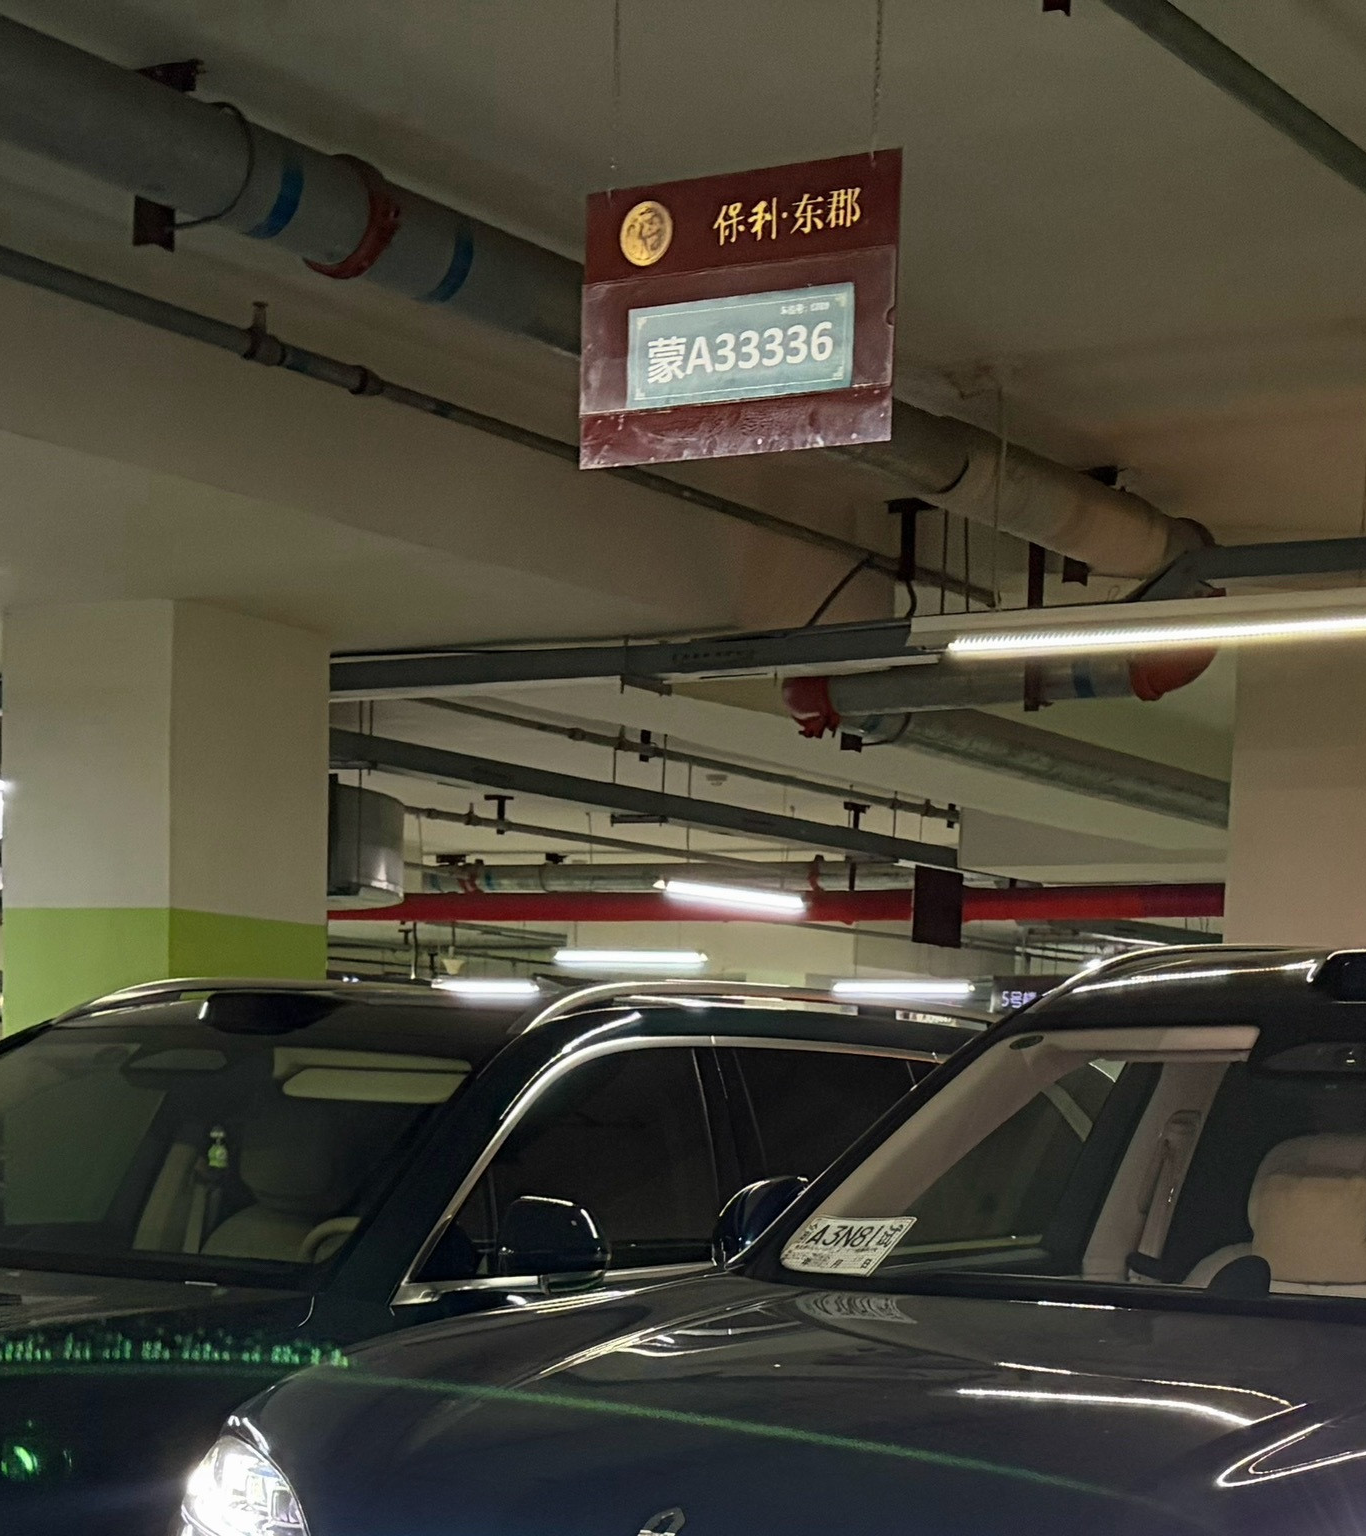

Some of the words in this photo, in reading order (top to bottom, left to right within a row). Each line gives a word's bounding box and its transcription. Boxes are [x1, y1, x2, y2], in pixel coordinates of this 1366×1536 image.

[712, 187, 862, 246] 保利·东郡
[647, 321, 834, 385] 蒙A33336
